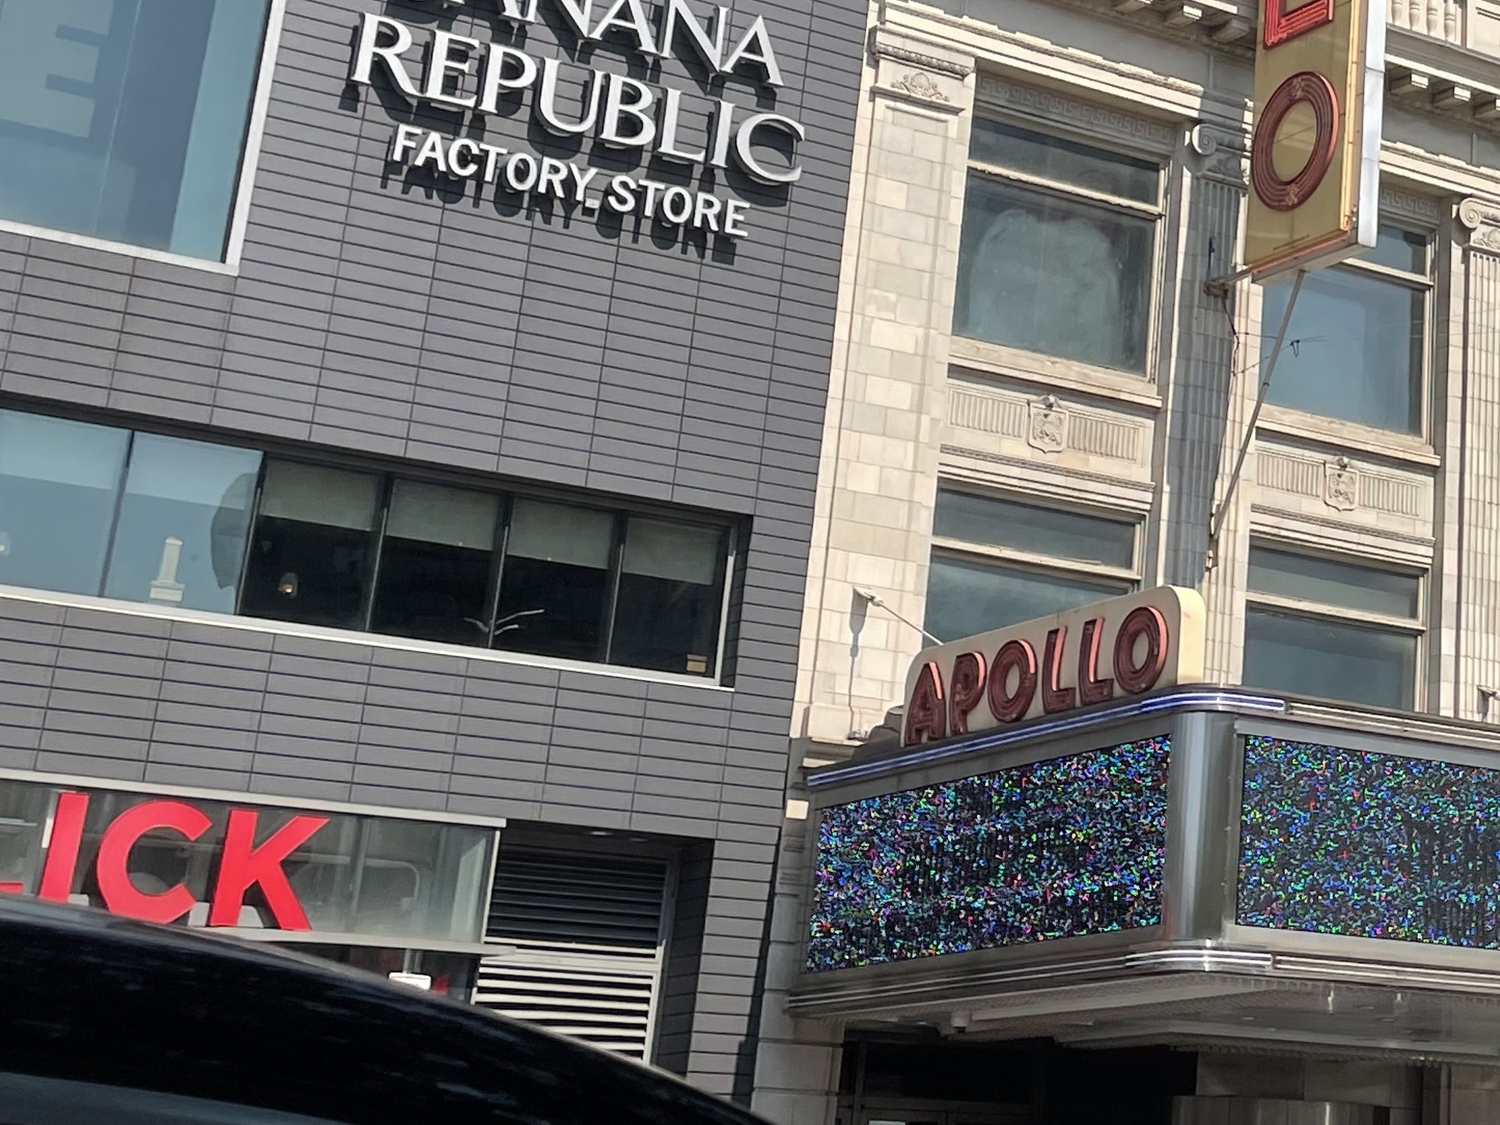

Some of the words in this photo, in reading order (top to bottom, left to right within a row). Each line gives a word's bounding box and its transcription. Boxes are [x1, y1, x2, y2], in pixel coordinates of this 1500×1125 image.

[351, 12, 805, 182] REPUBLIC
[393, 124, 598, 203] FACTORY
[607, 176, 751, 237] STORE
[906, 606, 1169, 746] APOLLO
[0, 791, 329, 931] ICK
